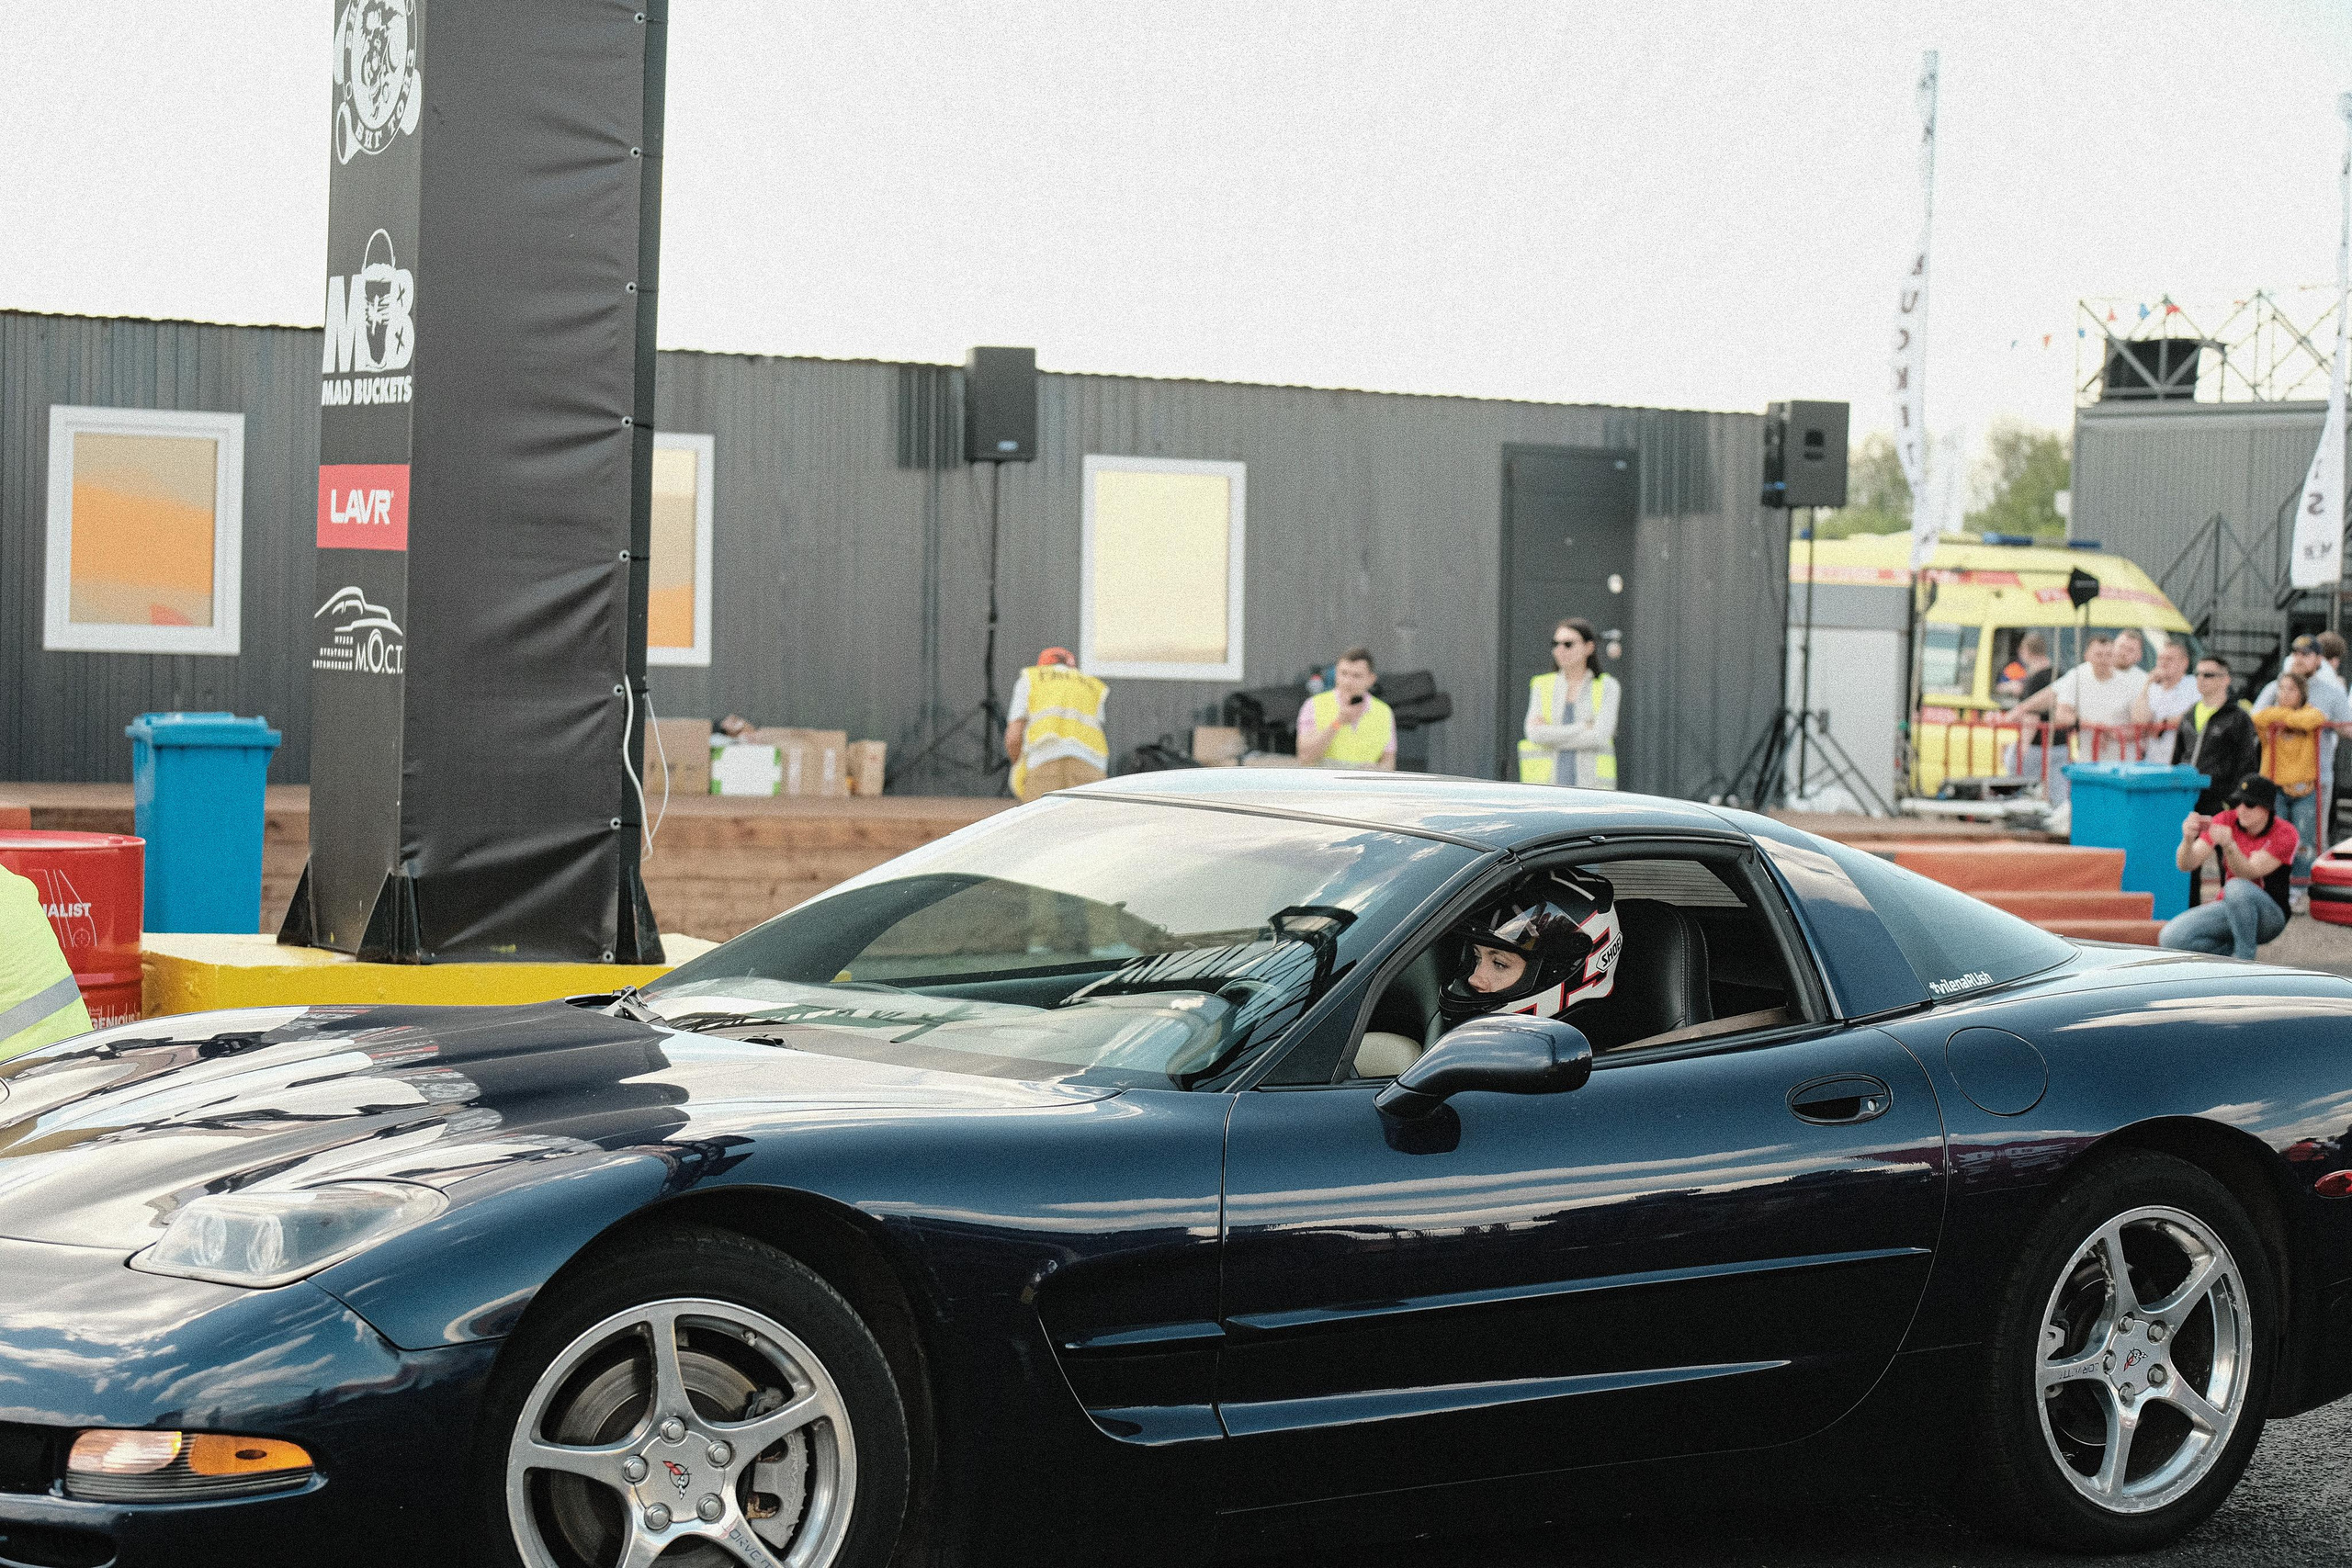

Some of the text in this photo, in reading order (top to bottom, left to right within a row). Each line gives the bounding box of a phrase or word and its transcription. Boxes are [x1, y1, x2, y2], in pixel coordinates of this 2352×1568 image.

[322, 375, 413, 406] MAD BUCKETS
[331, 489, 390, 525] LAVR
[42, 903, 91, 918] IALIST
